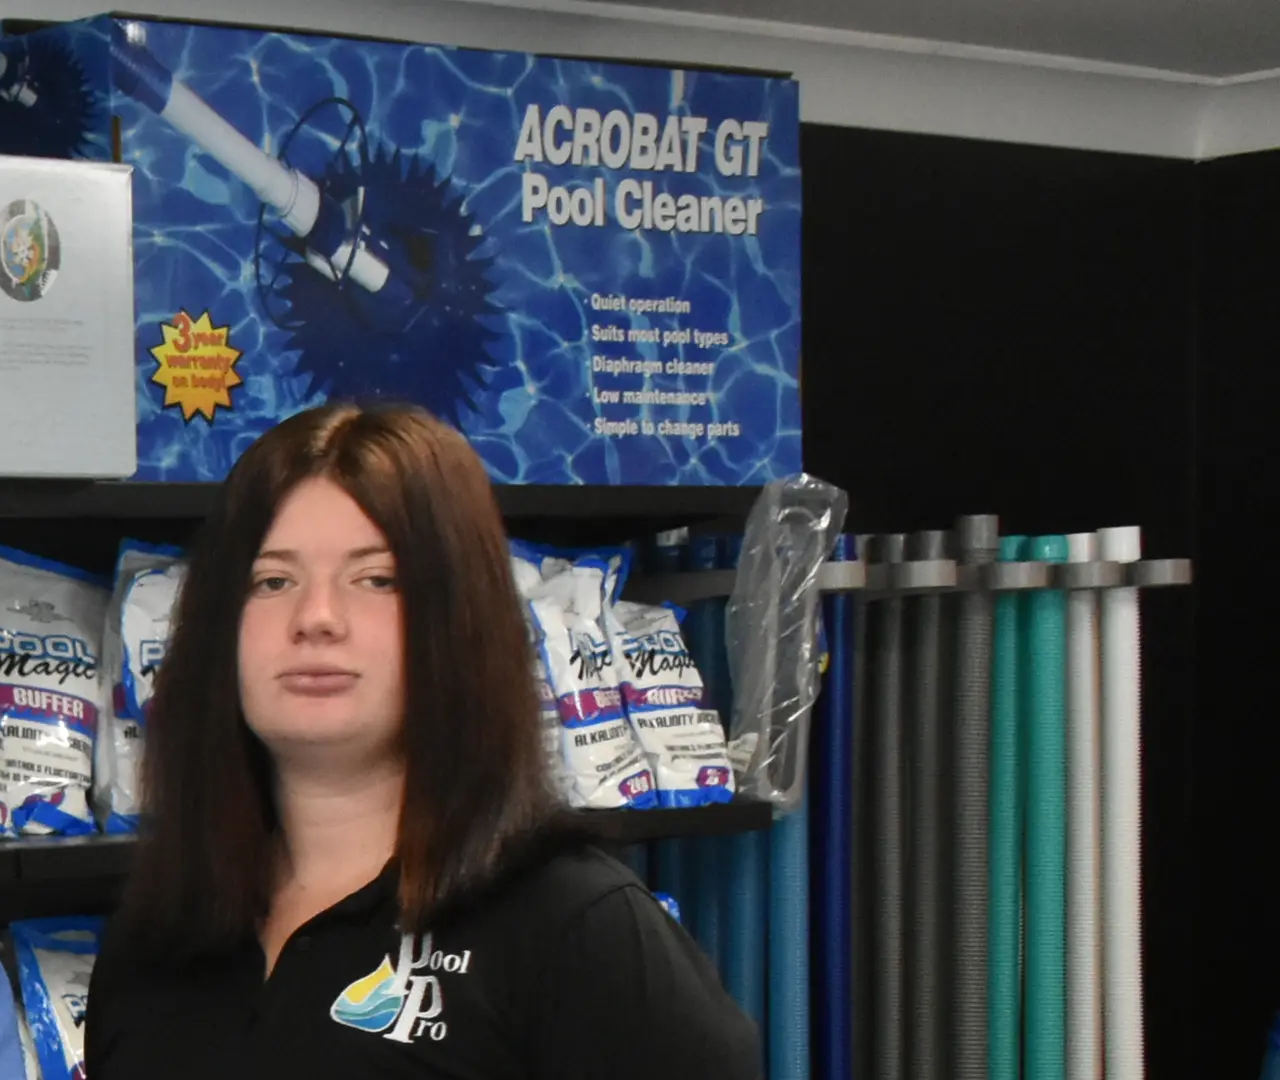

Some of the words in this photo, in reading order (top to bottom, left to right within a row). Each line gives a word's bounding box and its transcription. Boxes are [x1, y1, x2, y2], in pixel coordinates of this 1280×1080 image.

[513, 104, 707, 173] ACROBAT
[714, 118, 768, 177] GT
[522, 172, 605, 226] Pool
[614, 178, 763, 235] Cleaner
[591, 293, 626, 310] Quiet
[629, 296, 691, 314] operation
[172, 313, 191, 353] 3
[191, 331, 225, 350] year
[592, 324, 625, 342] Suits
[628, 327, 661, 343] most
[663, 328, 691, 347] pool
[693, 330, 730, 348] types
[164, 352, 233, 375] warranty
[593, 355, 662, 377] Diaphragm
[665, 358, 715, 375] cleaner
[172, 375, 189, 388] on
[594, 387, 620, 404] Low
[623, 389, 706, 405] maintenance
[594, 417, 639, 439] Simple
[642, 418, 655, 435] to
[657, 419, 704, 439] change
[707, 421, 740, 440] parts
[12, 687, 84, 719] BUFFER
[380, 931, 472, 996] Pool
[382, 974, 448, 1044] Pro
